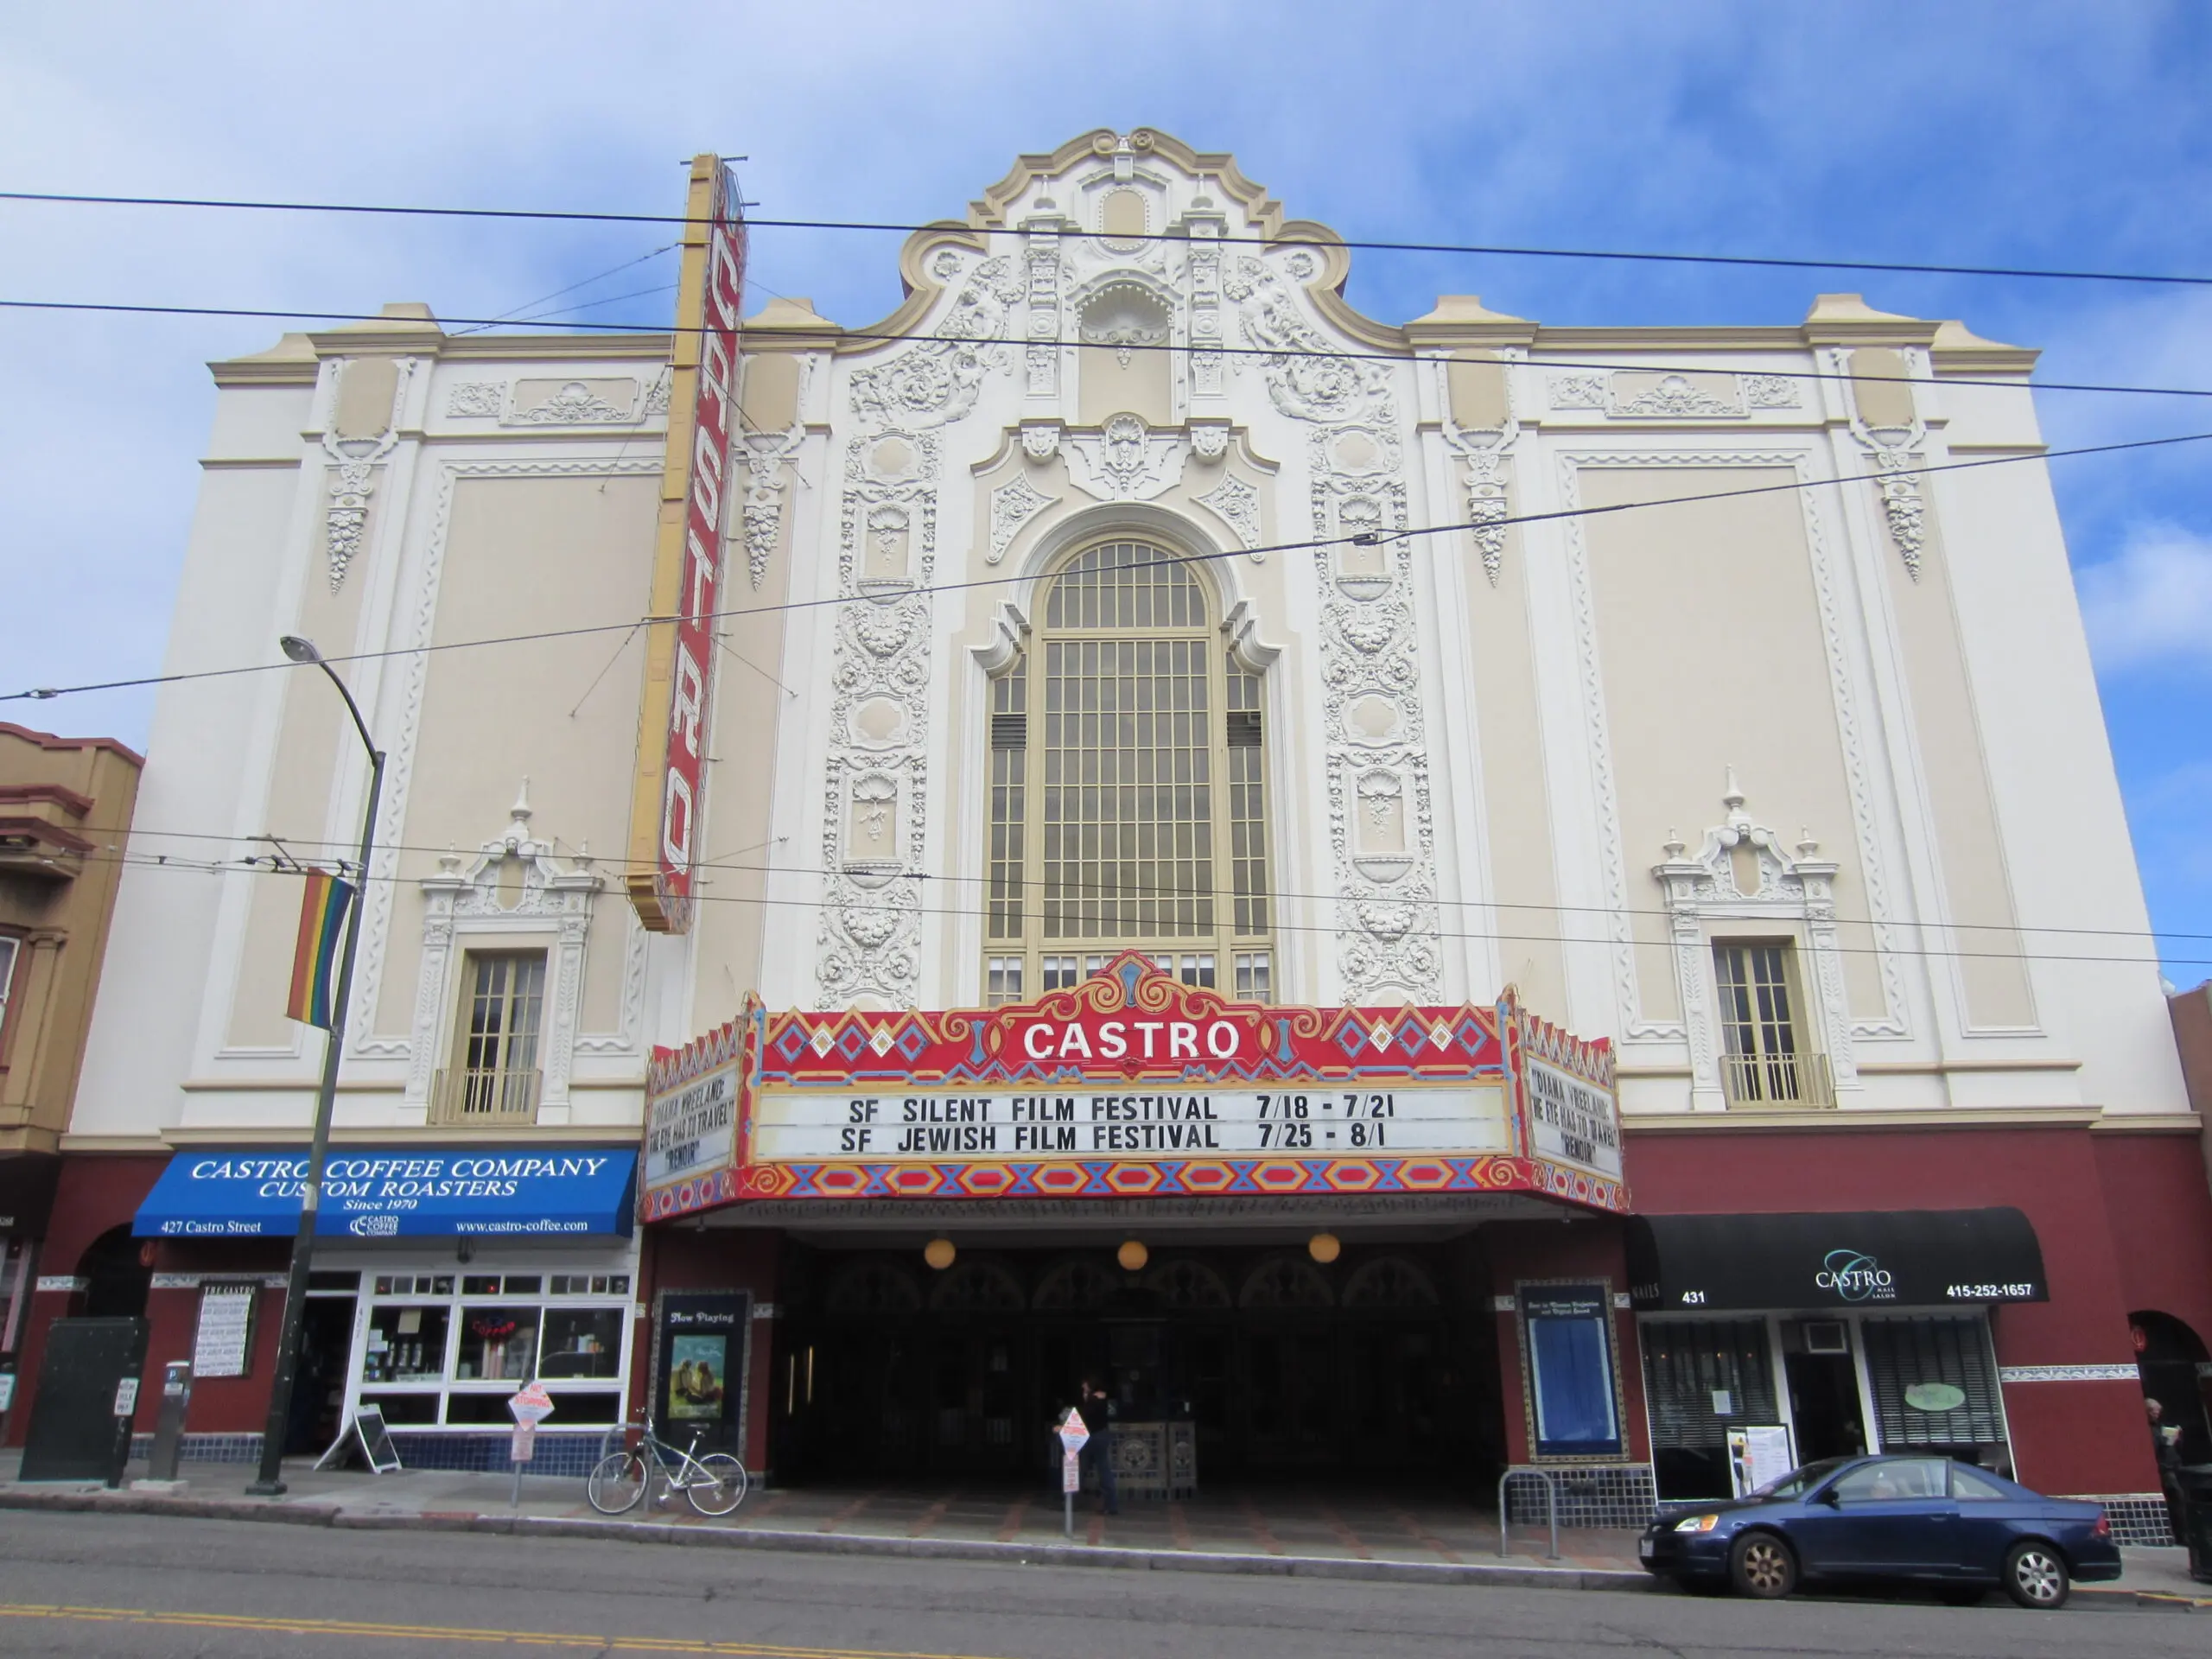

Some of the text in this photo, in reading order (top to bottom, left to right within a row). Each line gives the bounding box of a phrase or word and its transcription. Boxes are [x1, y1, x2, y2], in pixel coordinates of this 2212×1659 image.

[664, 227, 740, 874] CASTRO
[1024, 1021, 1240, 1059] CASTRO
[849, 1099, 879, 1123] SF
[903, 1099, 992, 1122] SILENT
[1012, 1097, 1074, 1122] FILM
[1091, 1096, 1217, 1121] FESTIVAL
[1256, 1095, 1308, 1119] 7/18
[1344, 1094, 1395, 1118] 7/21
[841, 1127, 872, 1152] SF
[898, 1126, 996, 1152] JEWISH
[1014, 1126, 1076, 1150] FILM
[1093, 1124, 1219, 1148] FESTIVAL
[1257, 1123, 1312, 1147] 7/25
[1351, 1122, 1384, 1147] 8/1
[1560, 1132, 1596, 1164] "RENOIR"
[192, 1158, 607, 1179] CASTRO COFFEE COMPANY
[379, 1180, 518, 1197] ROASTERS
[344, 1199, 417, 1211] Since 1970
[161, 1220, 262, 1234] 427 Castro Street
[456, 1218, 588, 1233] www.castro-coffee.com
[1815, 1270, 1891, 1287] CASTRO
[223, 1285, 256, 1296] CASTRO
[1632, 1283, 1659, 1300] NAILS
[1681, 1290, 1706, 1304] 431
[1946, 1283, 2032, 1298] 415-252-1657
[671, 1312, 734, 1325] Now Playing
